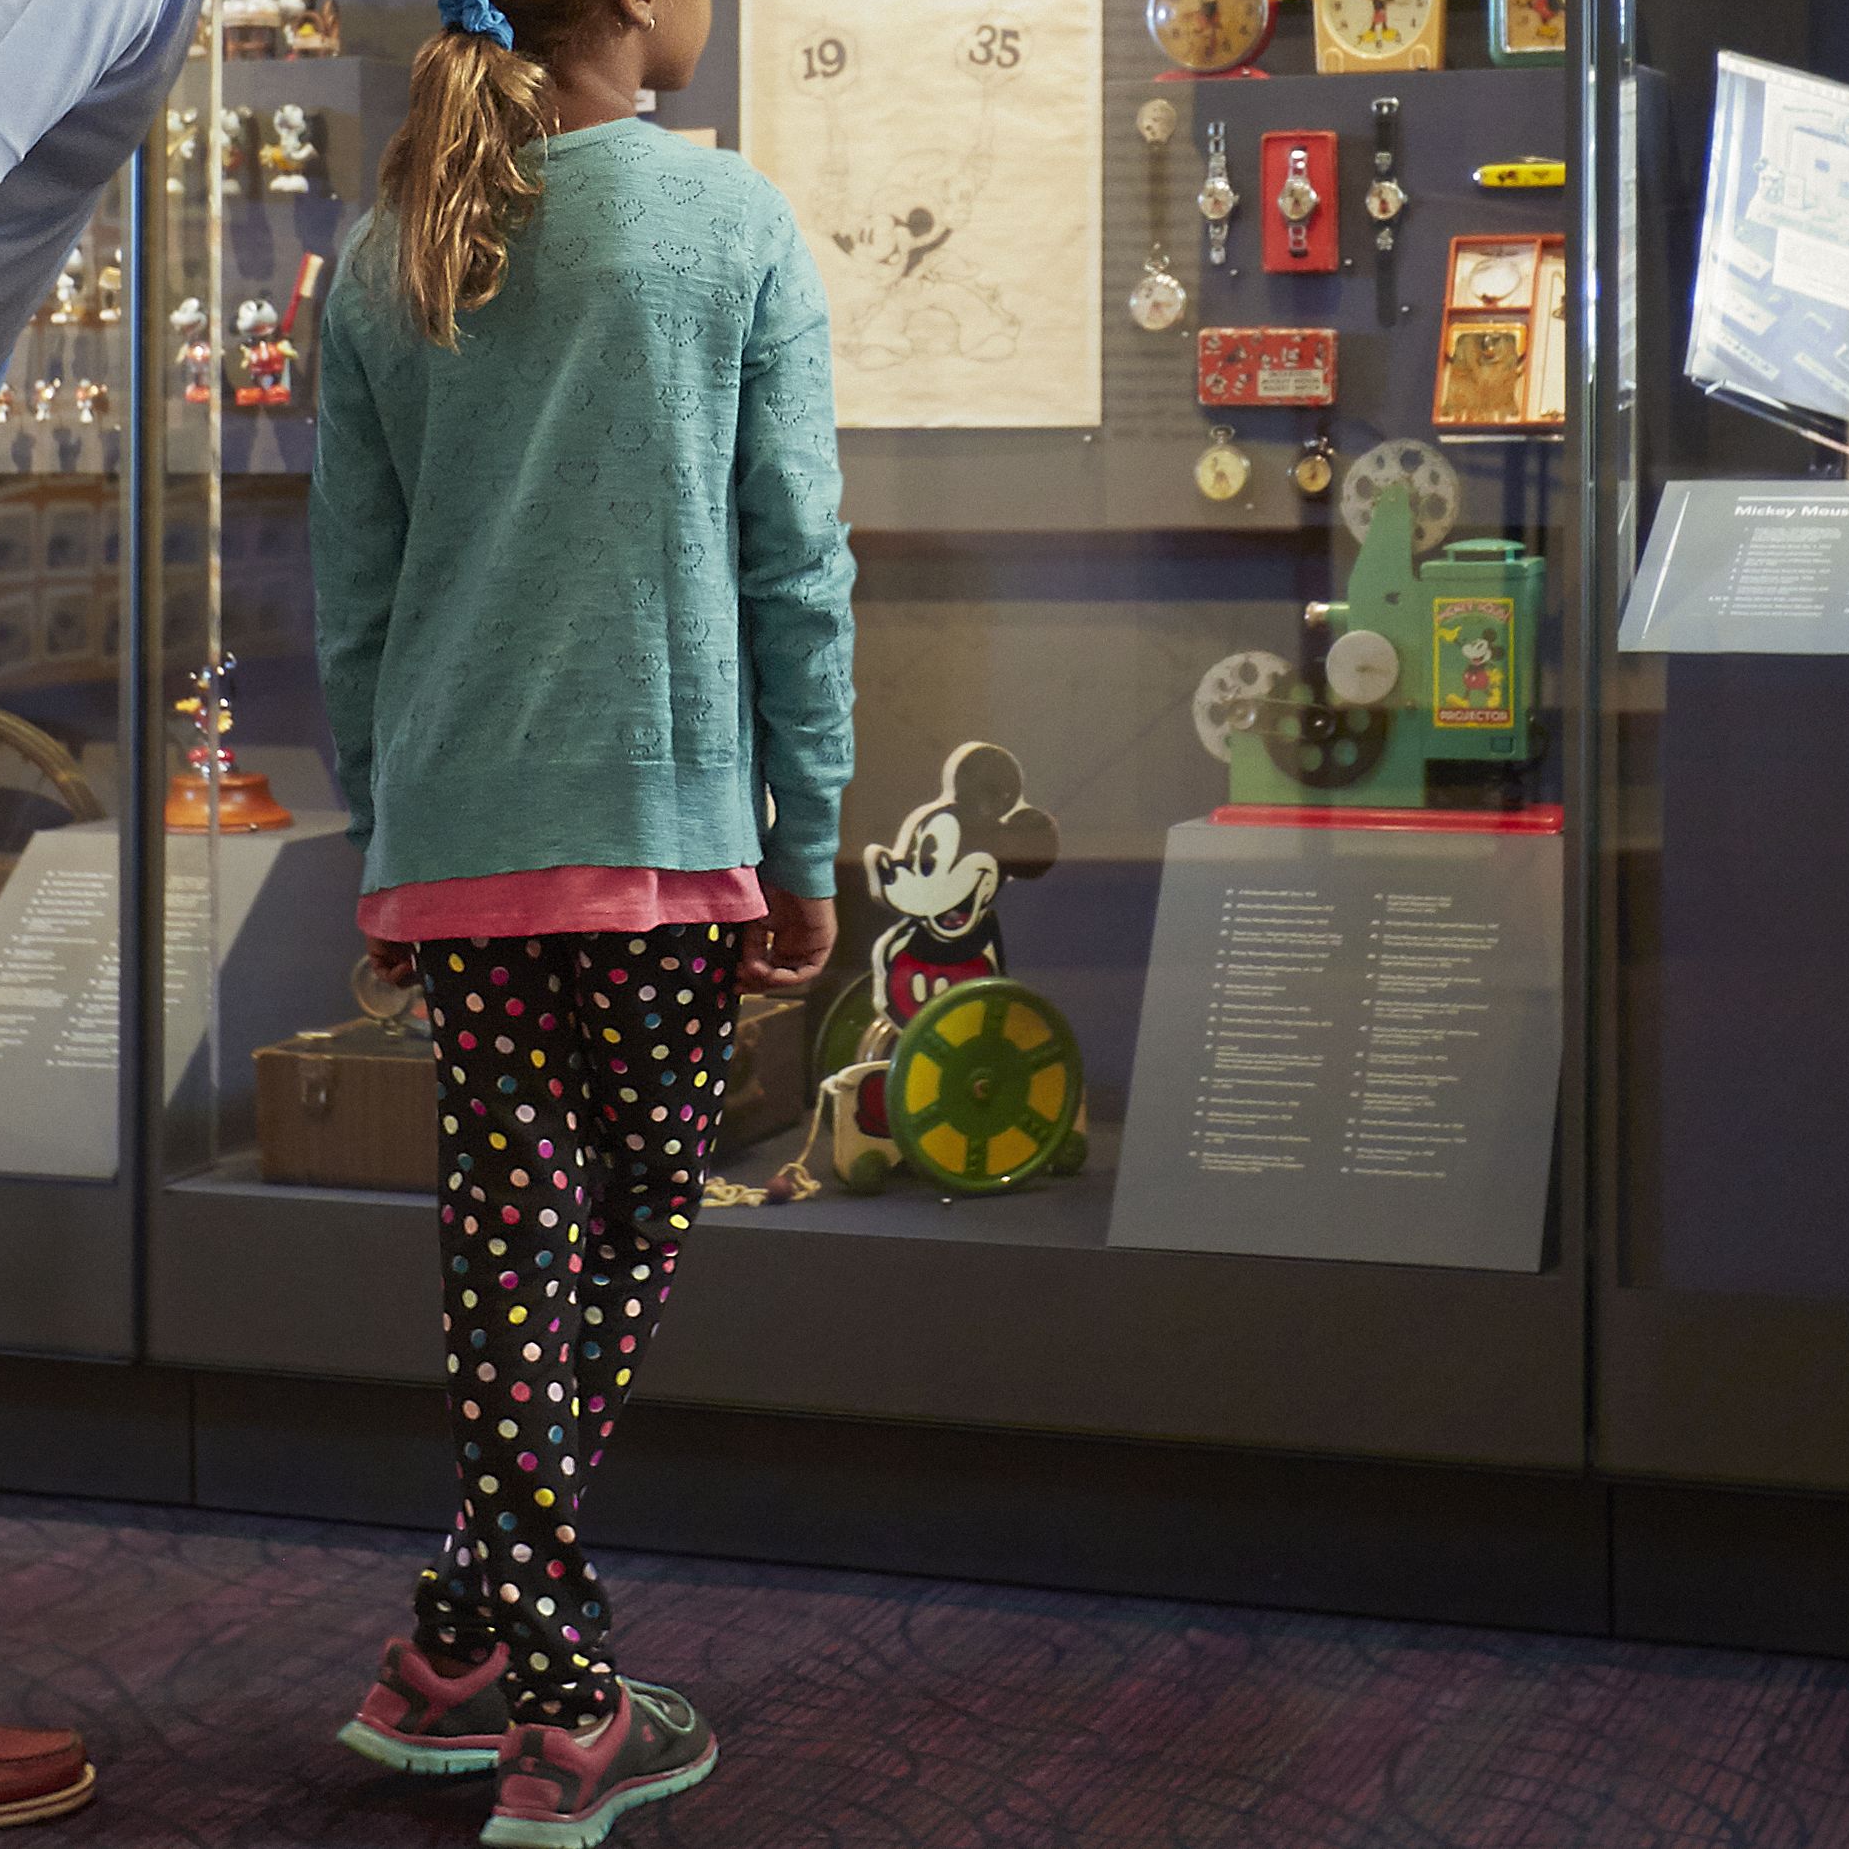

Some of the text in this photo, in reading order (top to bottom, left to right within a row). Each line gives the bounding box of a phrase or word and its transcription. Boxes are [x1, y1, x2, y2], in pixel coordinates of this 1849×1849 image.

[802, 37, 847, 81] 19
[968, 23, 1023, 69] 35
[1734, 505, 1796, 518] Mickey
[1439, 709, 1509, 723] PROJECTOR
